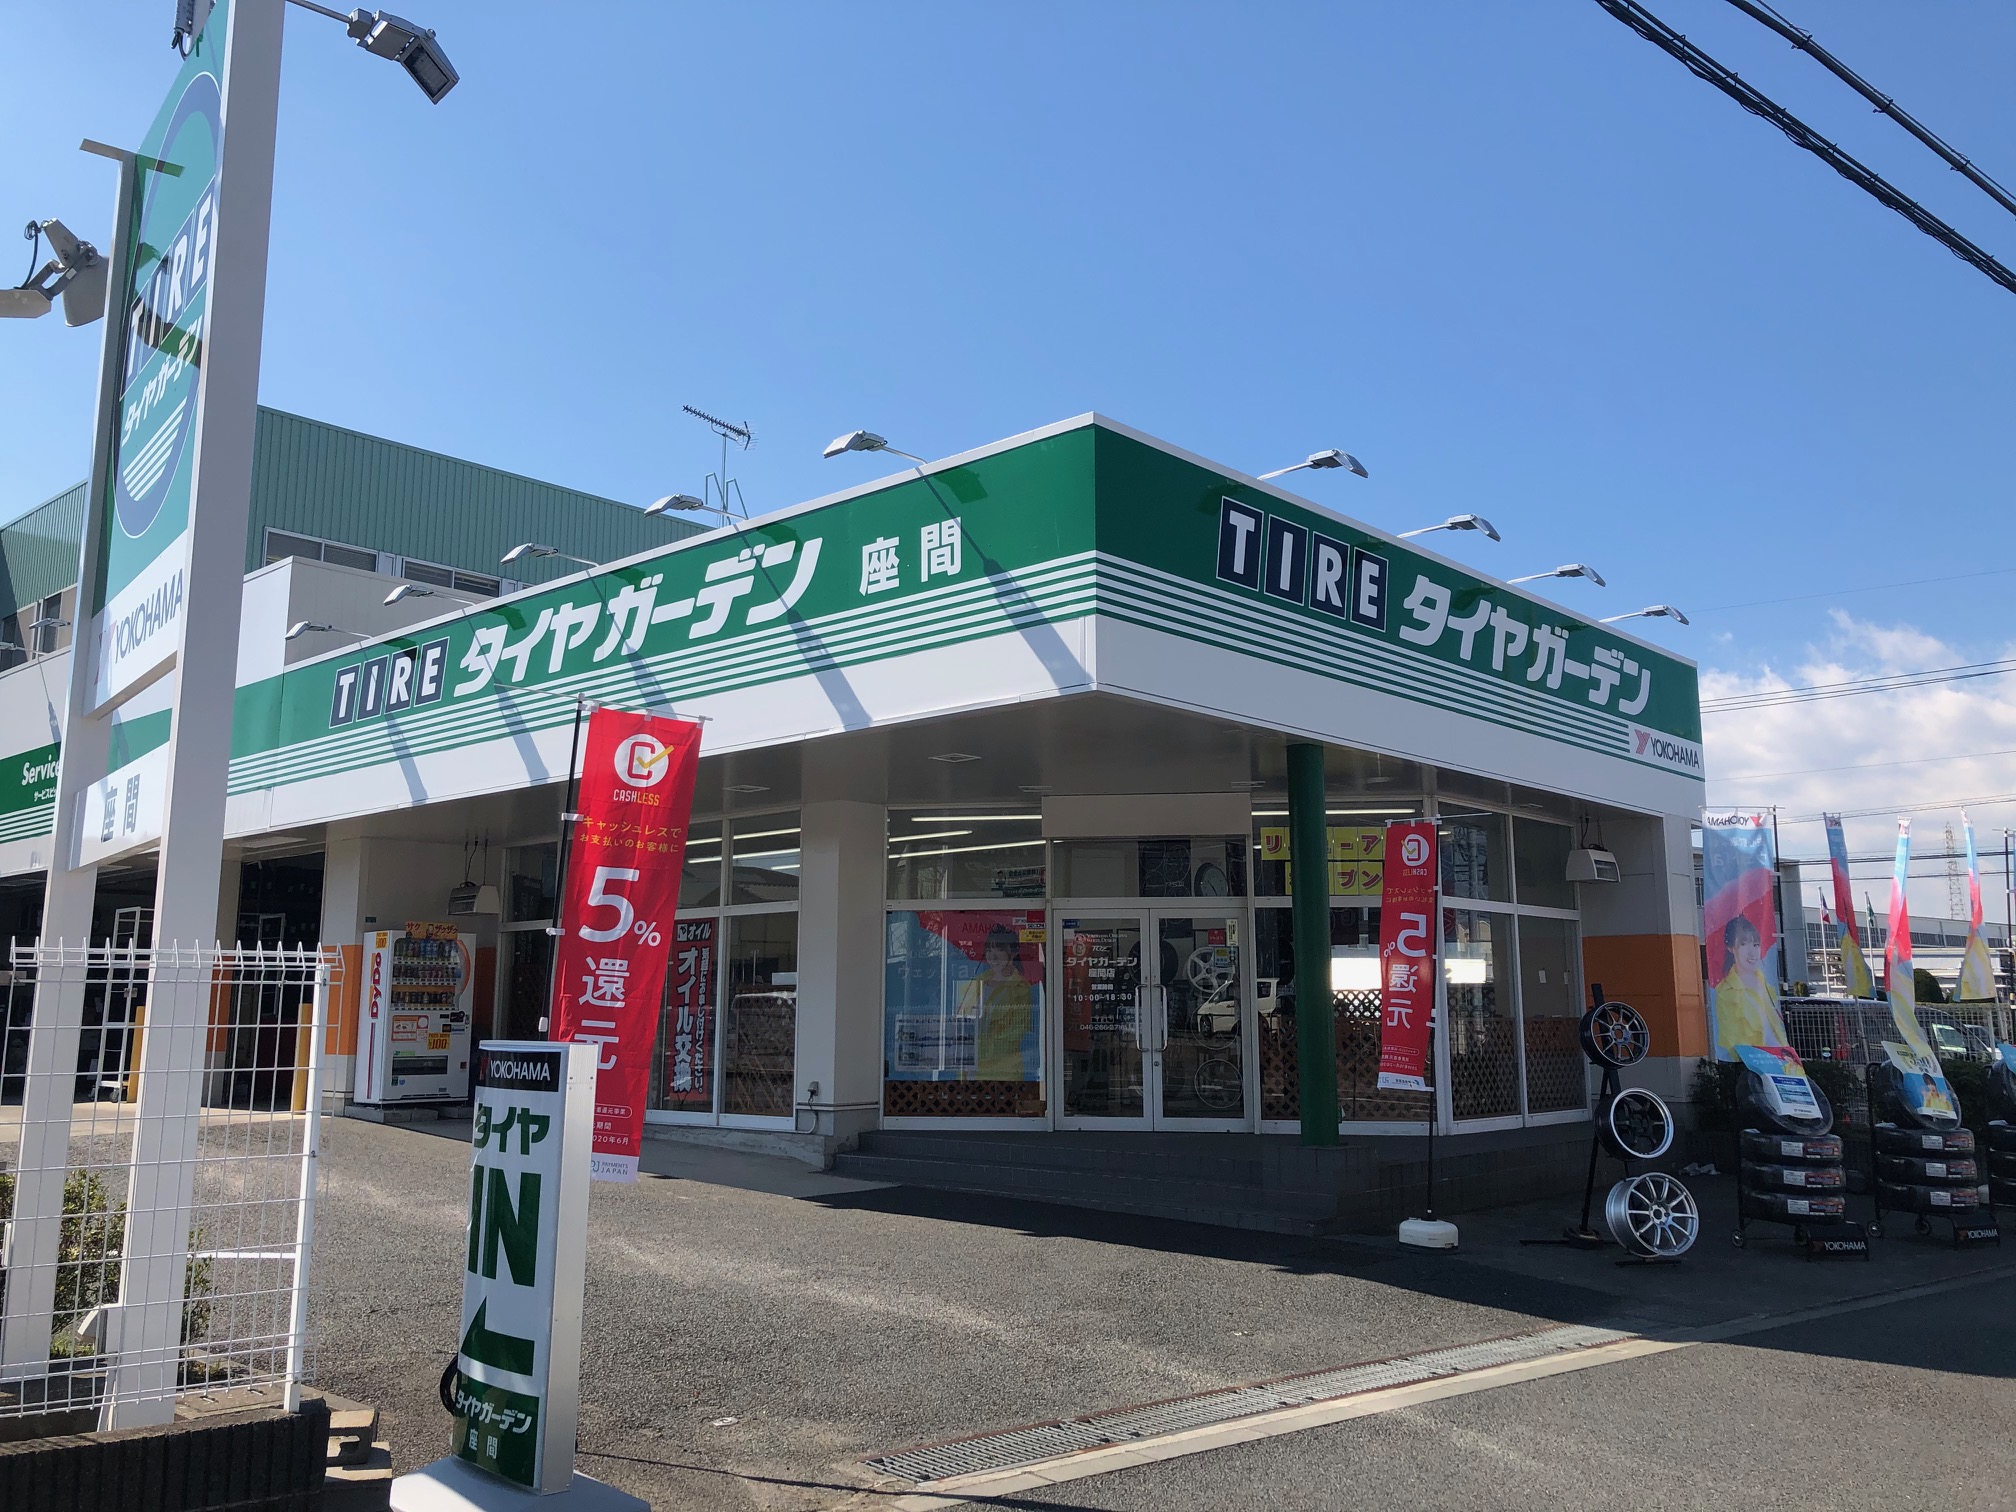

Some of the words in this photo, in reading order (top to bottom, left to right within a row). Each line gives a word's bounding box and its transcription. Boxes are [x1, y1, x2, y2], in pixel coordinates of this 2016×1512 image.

[128, 192, 212, 378] TIRE
[121, 314, 203, 448] タイヤガーデン
[114, 568, 183, 664] YOKOHAMA
[337, 646, 441, 722] TIRE
[454, 536, 823, 698] タイヤガーデン
[859, 517, 963, 597] 座間
[1228, 509, 1381, 620] TIRE
[1399, 573, 1651, 716] タイヤガーデン
[1650, 737, 1700, 770] YOKOHAMA
[100, 773, 141, 844] 座間
[613, 788, 660, 806] CASHLESS
[580, 833, 680, 853] お支払いのお客様に
[582, 815, 683, 839] キャッシュレスで
[578, 866, 662, 947] 5%
[688, 922, 711, 941] オイル
[1066, 956, 1138, 967] タイヤガーデン
[574, 955, 630, 1071] 還元
[673, 946, 698, 1093] オイル交換
[490, 1060, 551, 1081] YOKOHAMA
[473, 1103, 551, 1155] タイヤ
[601, 1167, 628, 1175] JAPAN
[602, 1161, 629, 1169] PAYMENTS
[467, 1164, 541, 1288] IN
[1824, 1240, 1867, 1251] YOKOHAMA
[1967, 1228, 1999, 1239] YOKOHAMA
[455, 1388, 533, 1434] タイヤガーデン
[468, 1428, 499, 1460] 座間
